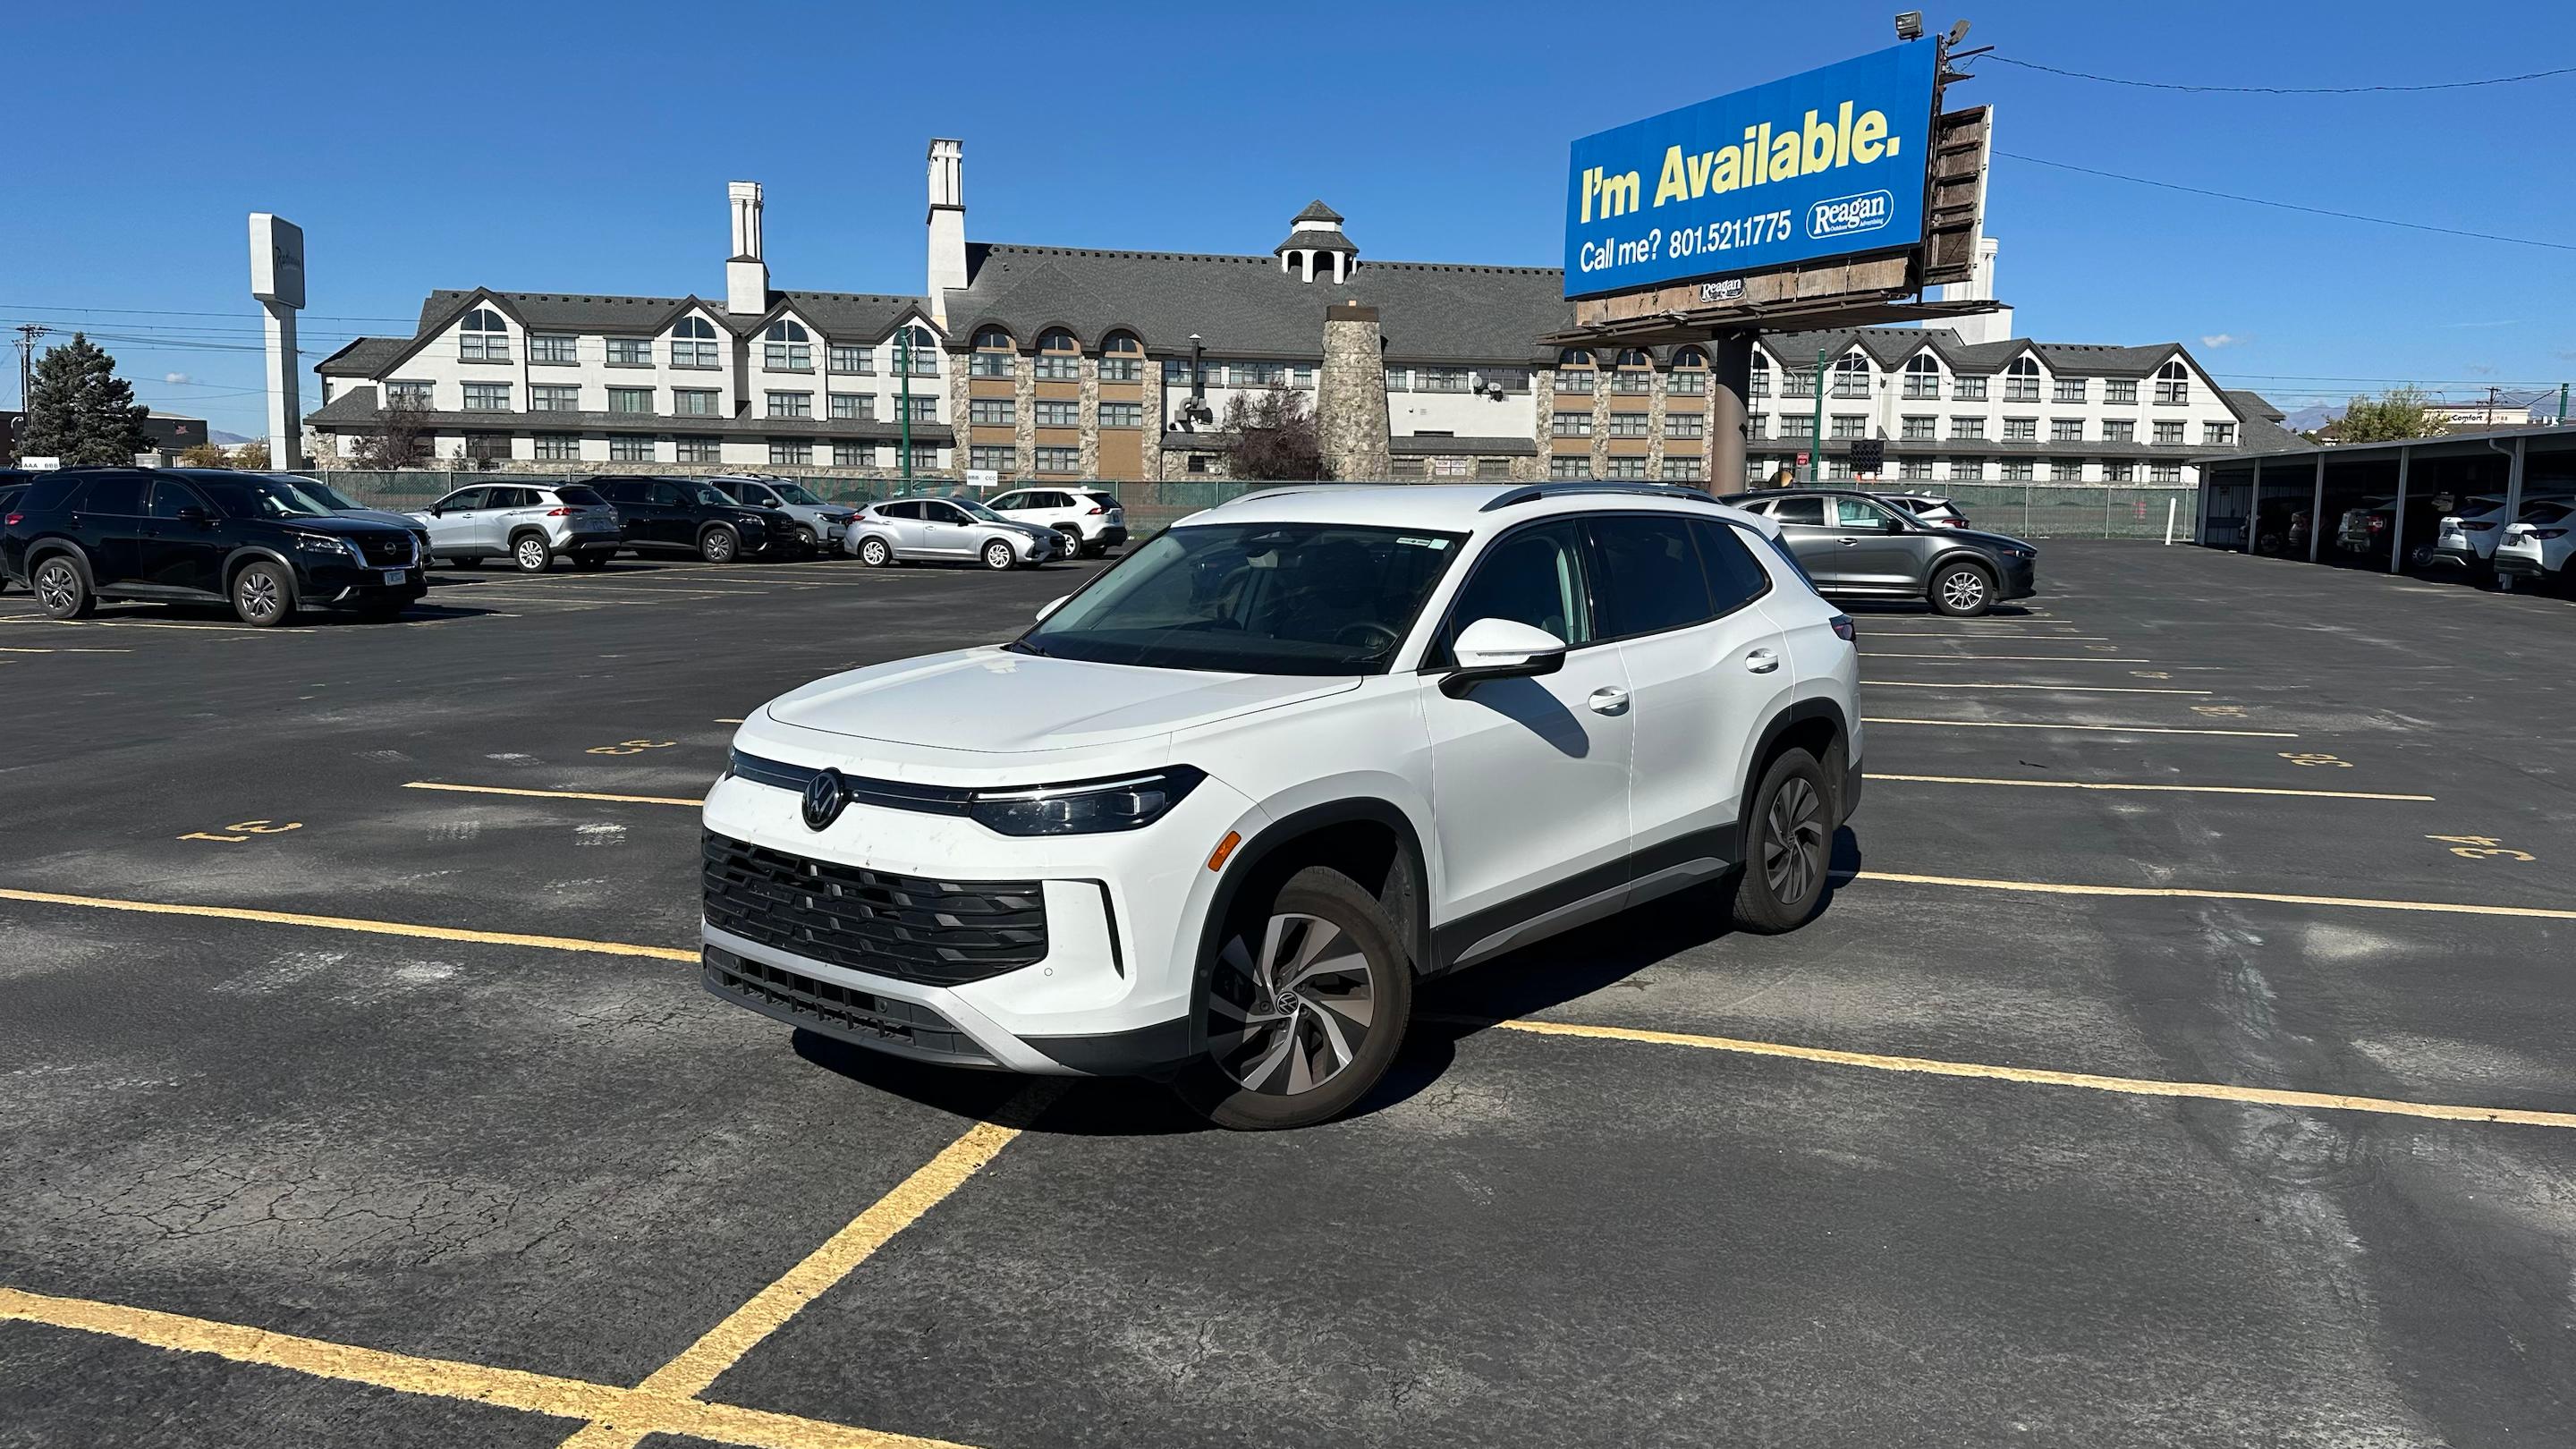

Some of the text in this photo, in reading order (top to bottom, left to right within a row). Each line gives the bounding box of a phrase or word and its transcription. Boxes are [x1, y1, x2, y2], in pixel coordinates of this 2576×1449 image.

[1580, 99, 1901, 225] I'm Available.
[1813, 196, 1885, 234] Reagan
[1580, 209, 1792, 274] Call me? 801.521.1775
[1701, 278, 1741, 300] Reagan
[2451, 414, 2483, 423] Comfort
[584, 740, 677, 755] 33
[2276, 751, 2354, 768] 36
[175, 819, 303, 843] 31
[2423, 835, 2538, 861] 34
